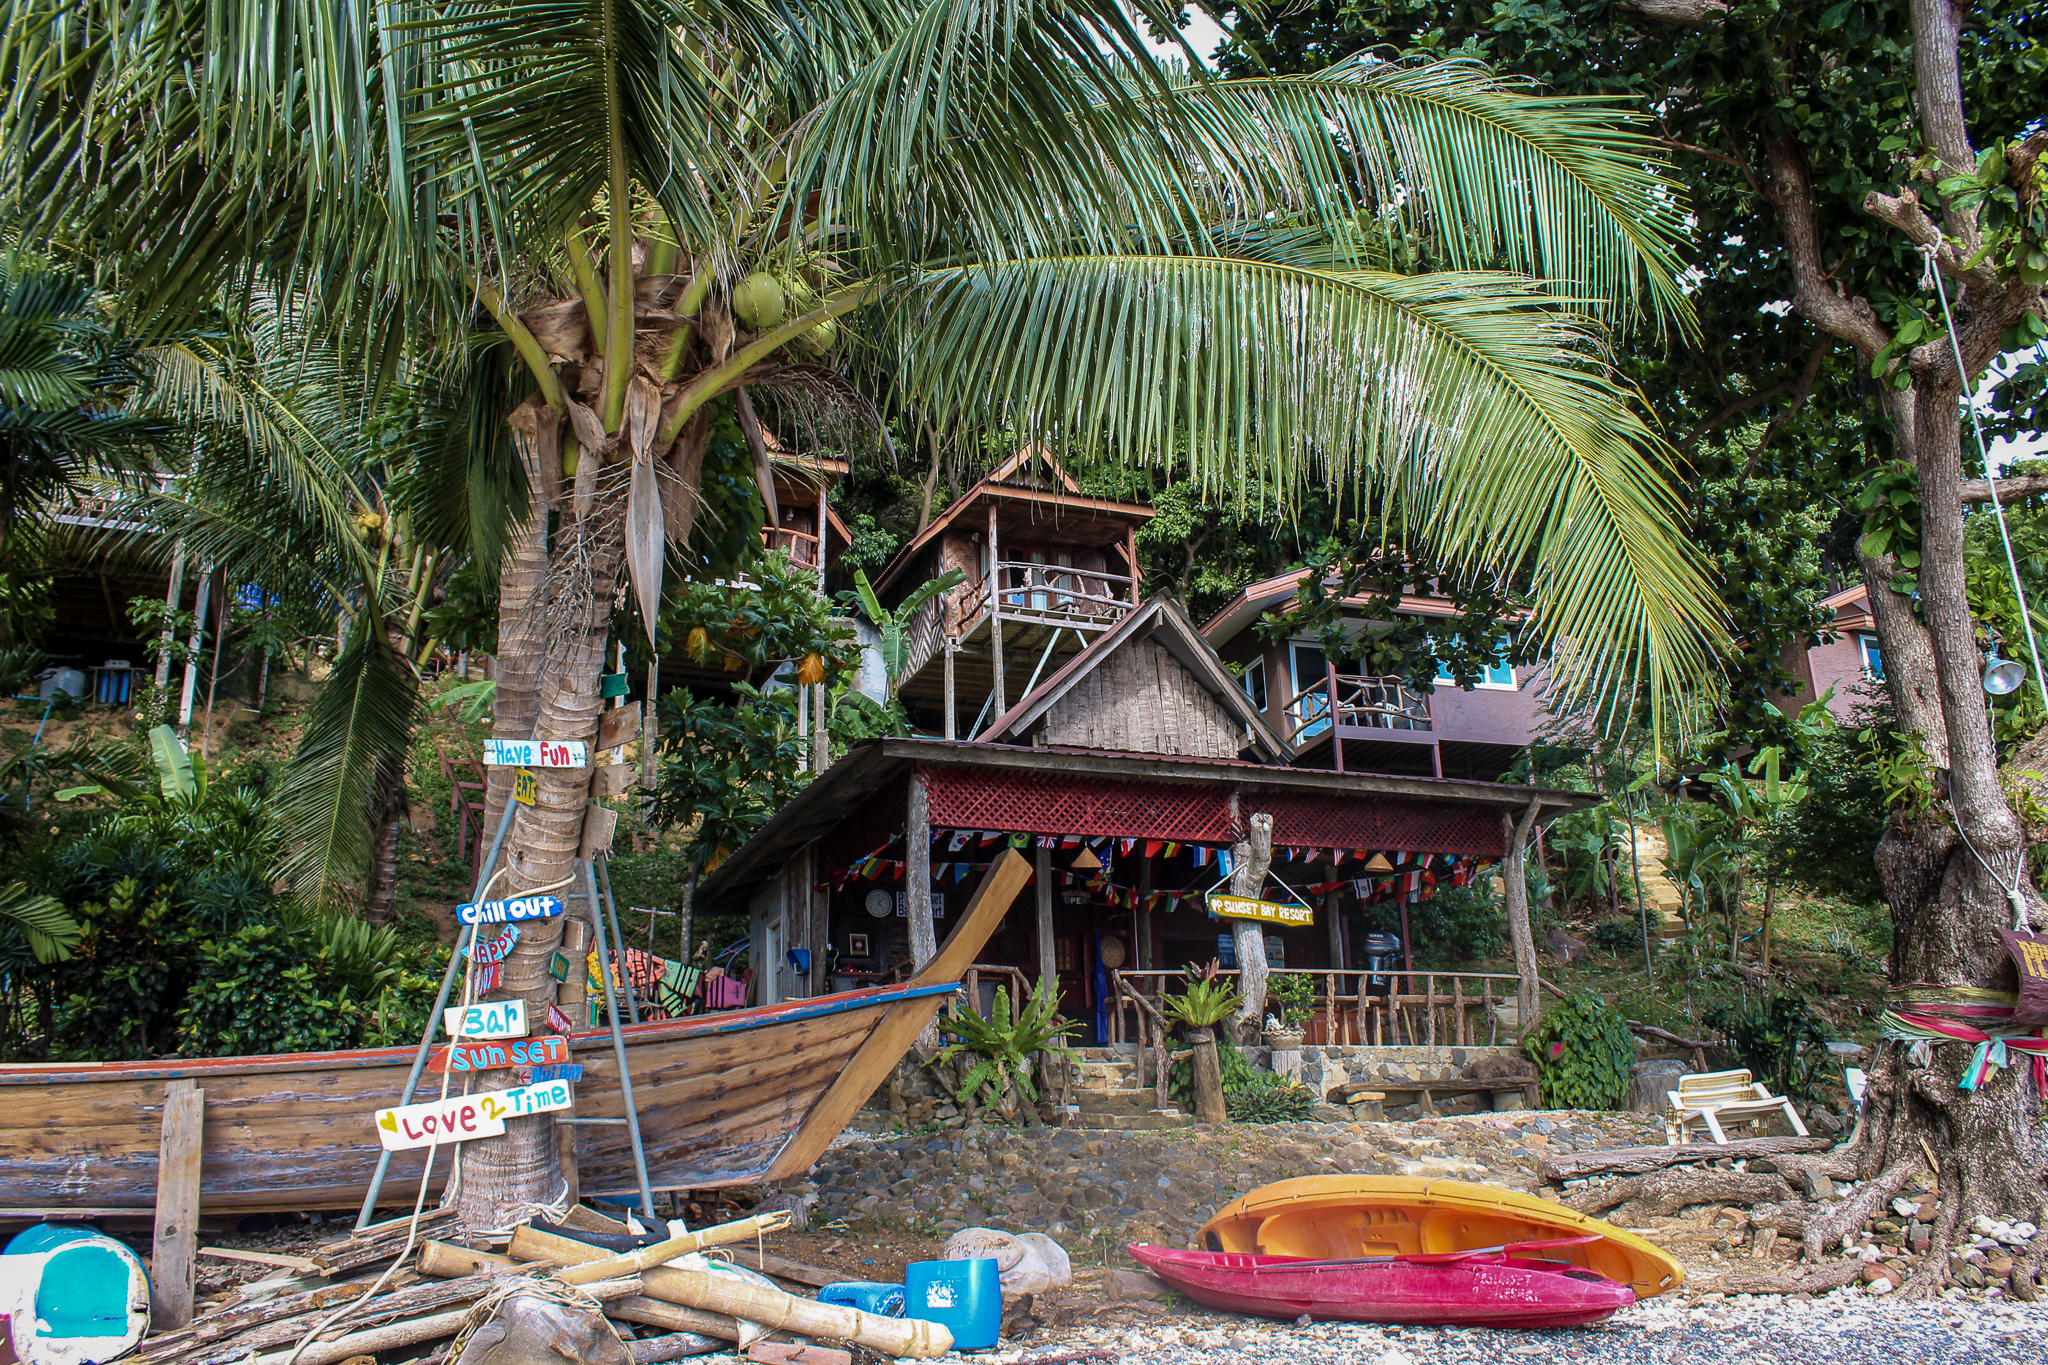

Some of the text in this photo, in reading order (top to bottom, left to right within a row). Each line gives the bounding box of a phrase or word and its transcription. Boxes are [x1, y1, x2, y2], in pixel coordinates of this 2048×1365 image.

[495, 740, 570, 766] Have Fun
[516, 773, 535, 799] EAT
[1223, 900, 1258, 915] SUNSET
[1261, 903, 1276, 918] BAY
[1279, 906, 1311, 922] RESORT
[468, 928, 516, 963] HAPPY
[465, 1004, 518, 1035] Bar
[402, 1085, 567, 1140] Love 2 Time
